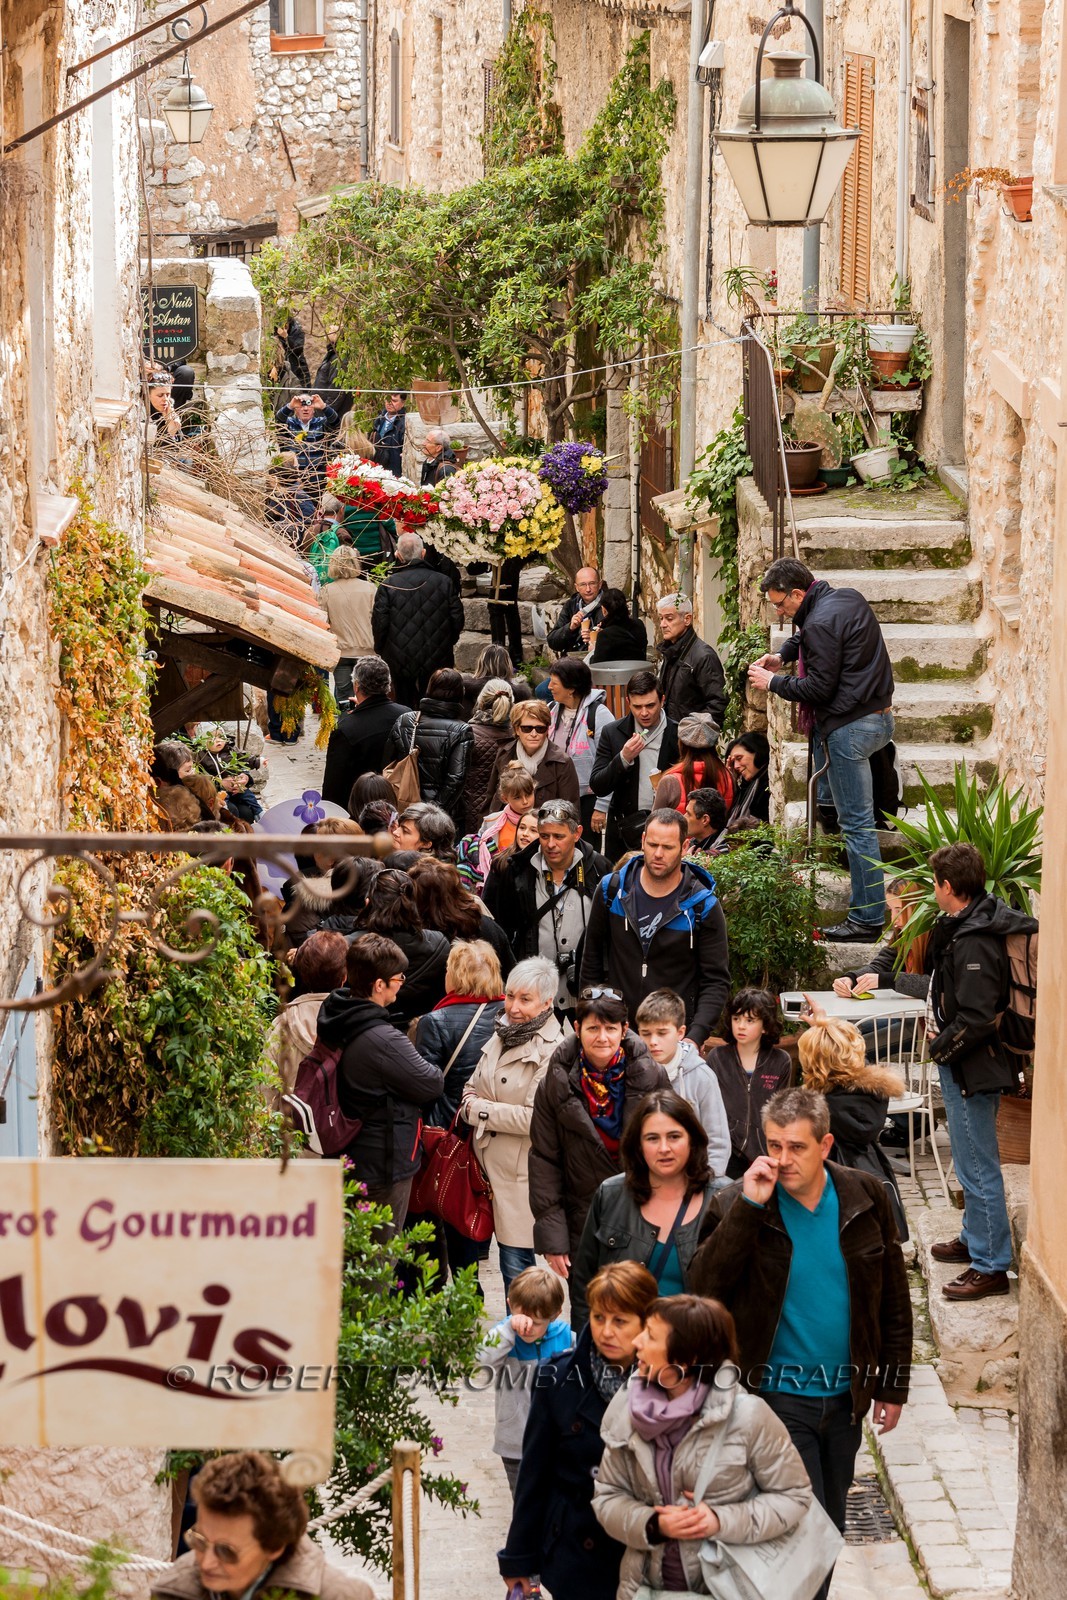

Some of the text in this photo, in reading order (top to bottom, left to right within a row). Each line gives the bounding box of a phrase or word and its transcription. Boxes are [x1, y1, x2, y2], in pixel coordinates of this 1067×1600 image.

[158, 292, 193, 309] Nuits
[79, 1199, 318, 1252] Gourmand
[0, 1273, 293, 1382] lovis
